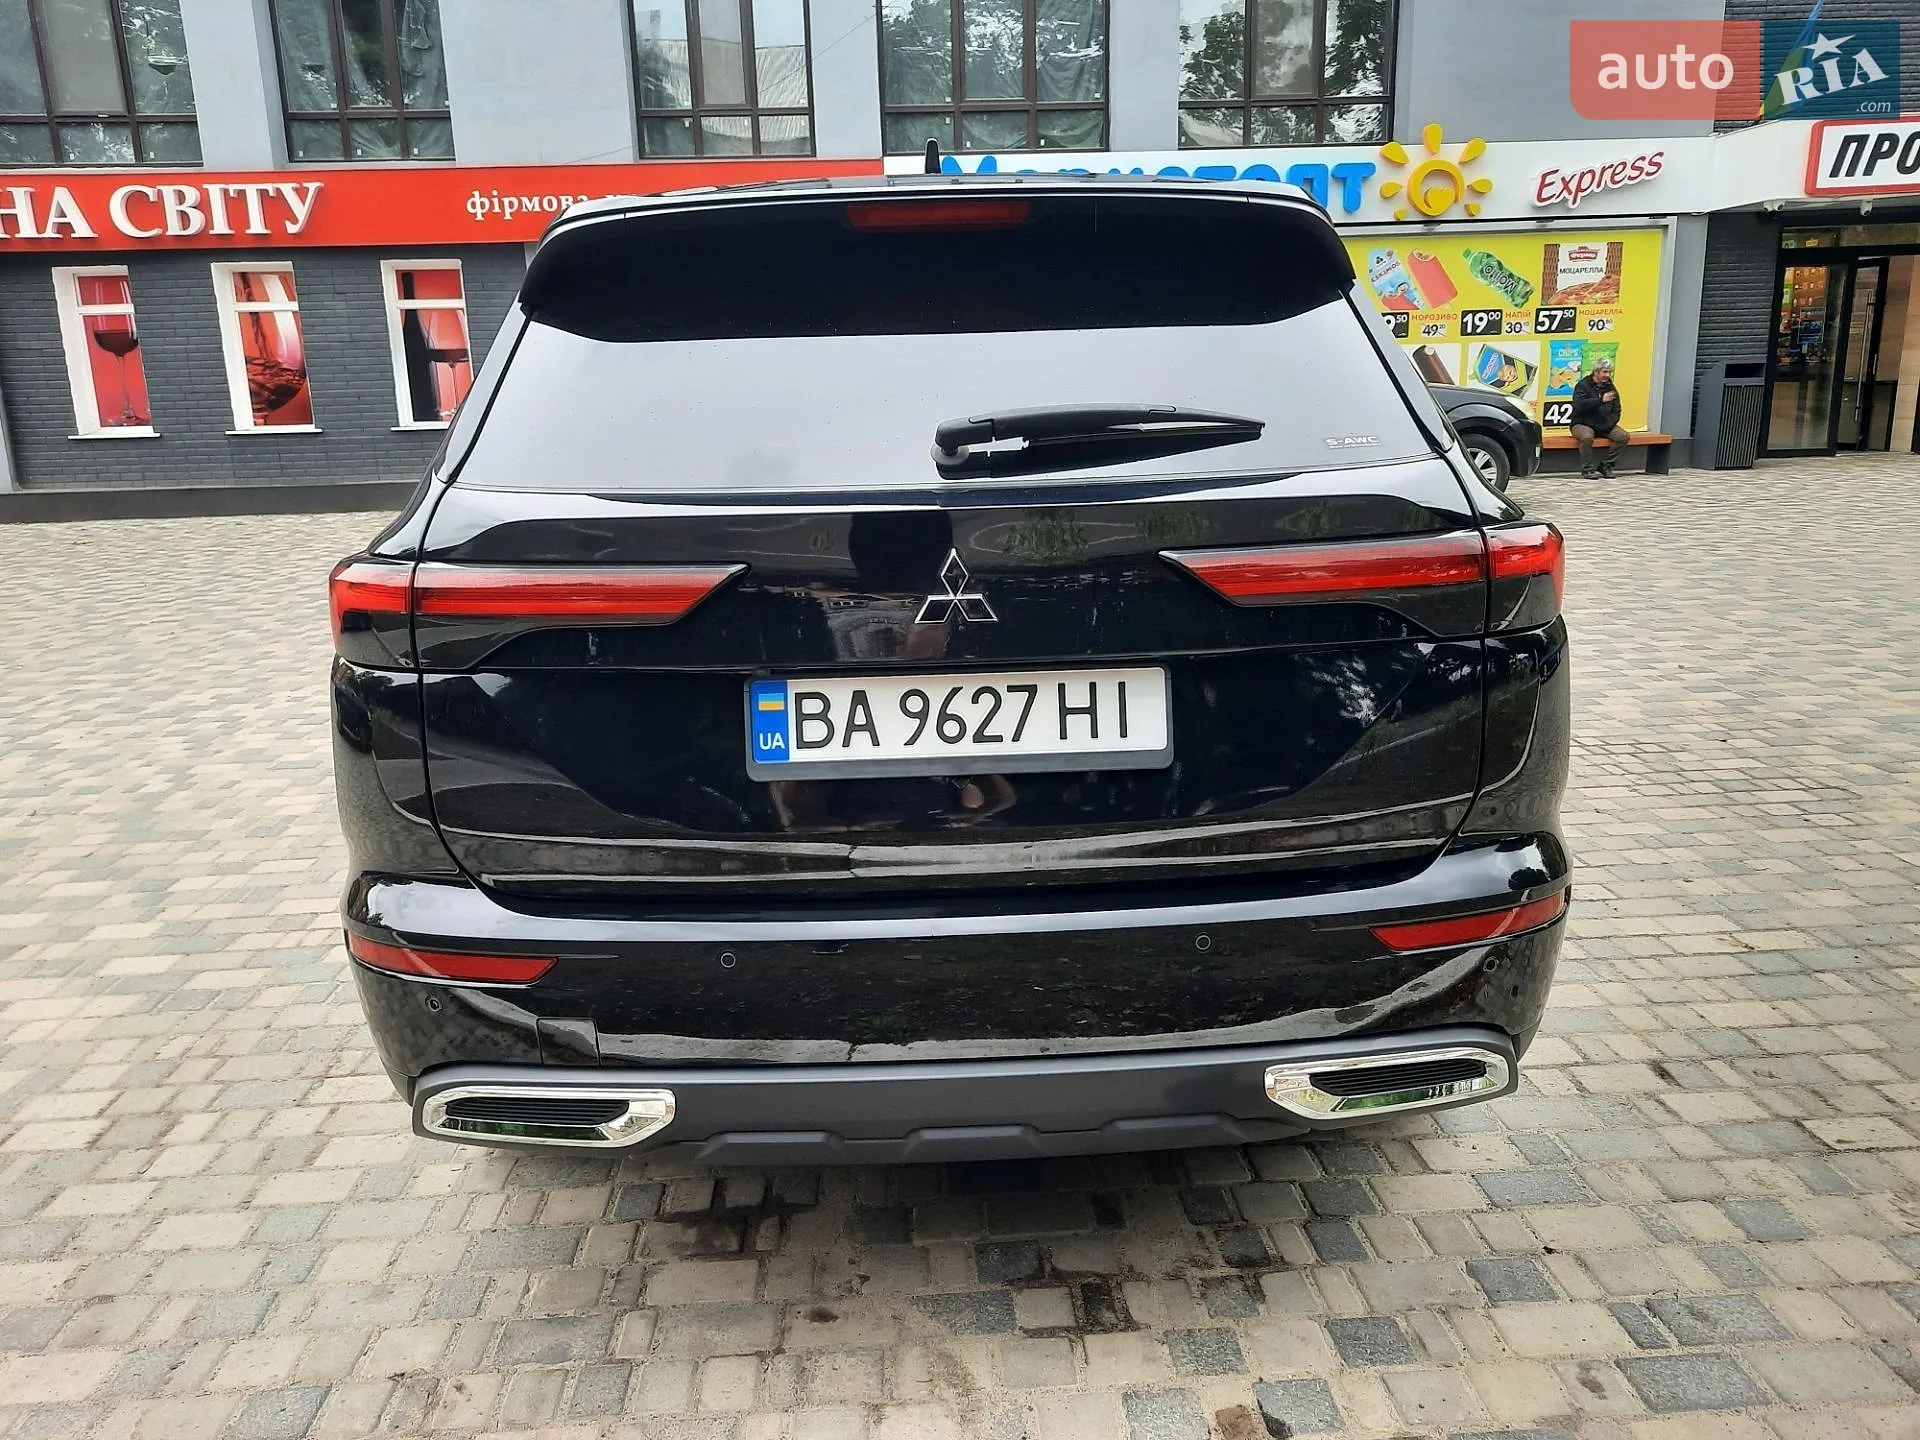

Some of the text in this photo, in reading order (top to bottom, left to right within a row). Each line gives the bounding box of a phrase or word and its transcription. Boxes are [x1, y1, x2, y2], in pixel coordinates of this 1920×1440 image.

[1535, 150, 1665, 206] Express
[109, 181, 324, 238] СВІТУ
[1559, 266, 1604, 274] МОЦАРЕЛЛА
[1411, 313, 1458, 321] МОРОЗИВО
[1505, 310, 1531, 319] НАПІЙ
[1545, 403, 1573, 424] 42
[1325, 436, 1379, 446] S-AWC
[795, 681, 1128, 749] BA 9627 HI
[759, 732, 785, 750] UA
